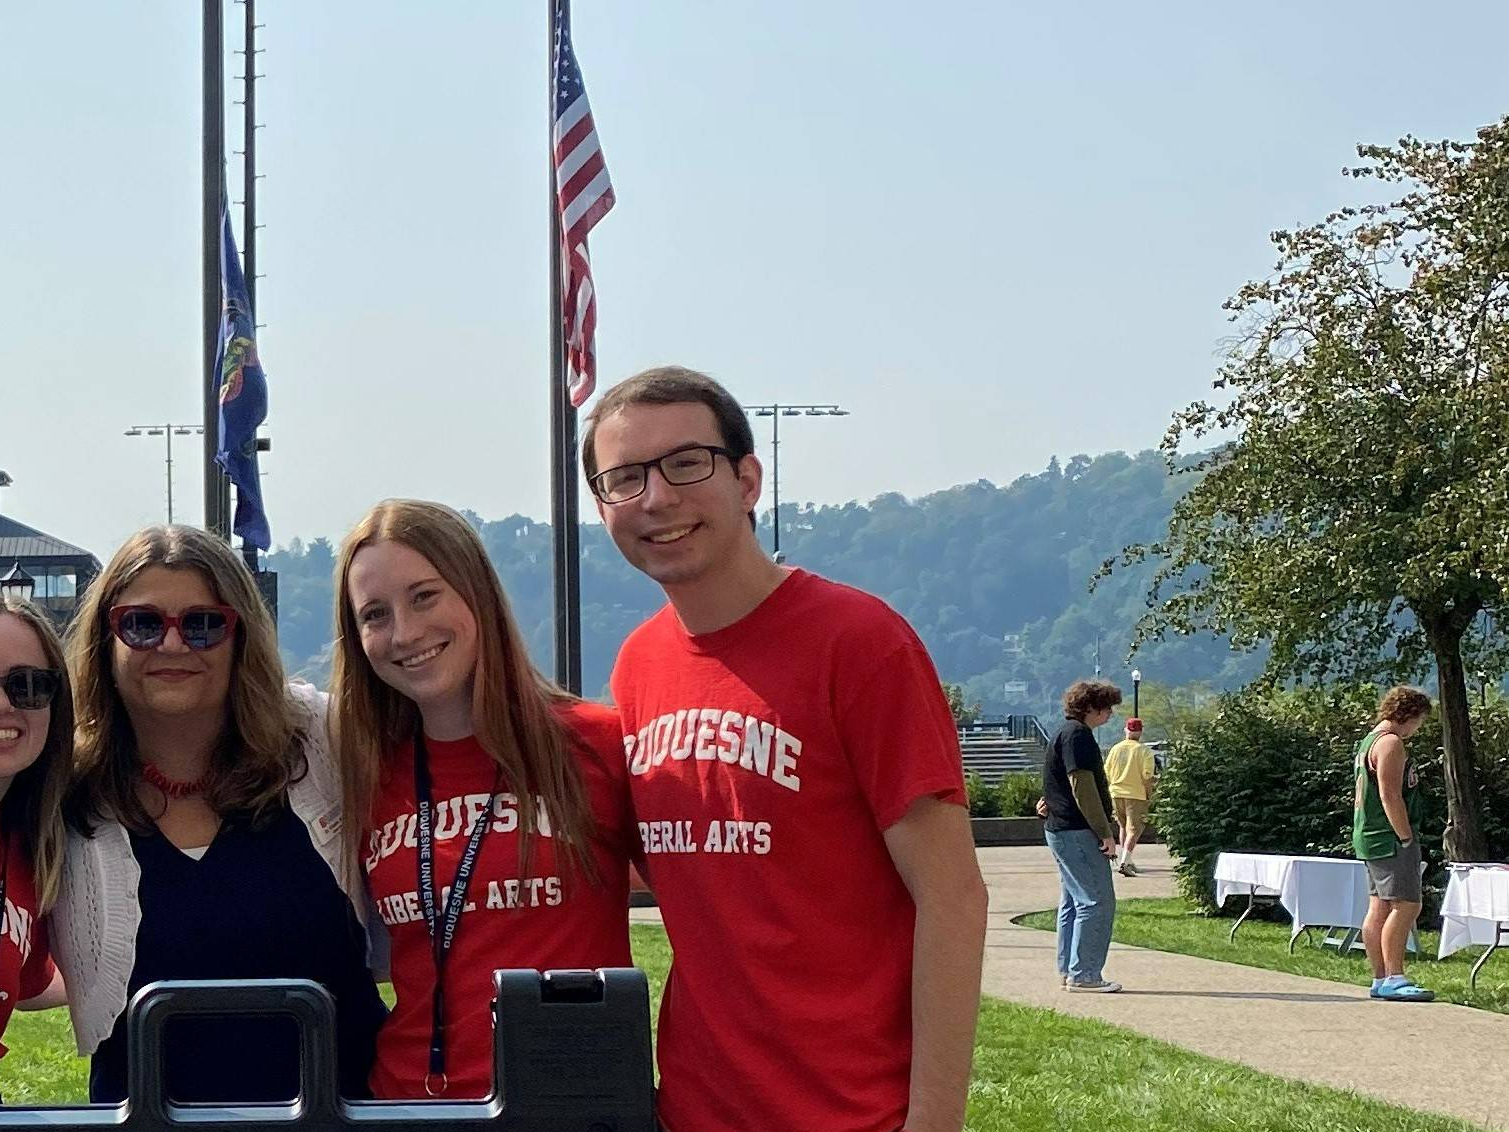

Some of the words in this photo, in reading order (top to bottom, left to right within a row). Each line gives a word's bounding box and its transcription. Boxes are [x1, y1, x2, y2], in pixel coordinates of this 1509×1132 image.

[419, 801, 431, 859] DUQUESNE
[704, 820, 772, 854] ARTS
[443, 880, 467, 949] DUQUESNE
[486, 876, 563, 909] ARTS
